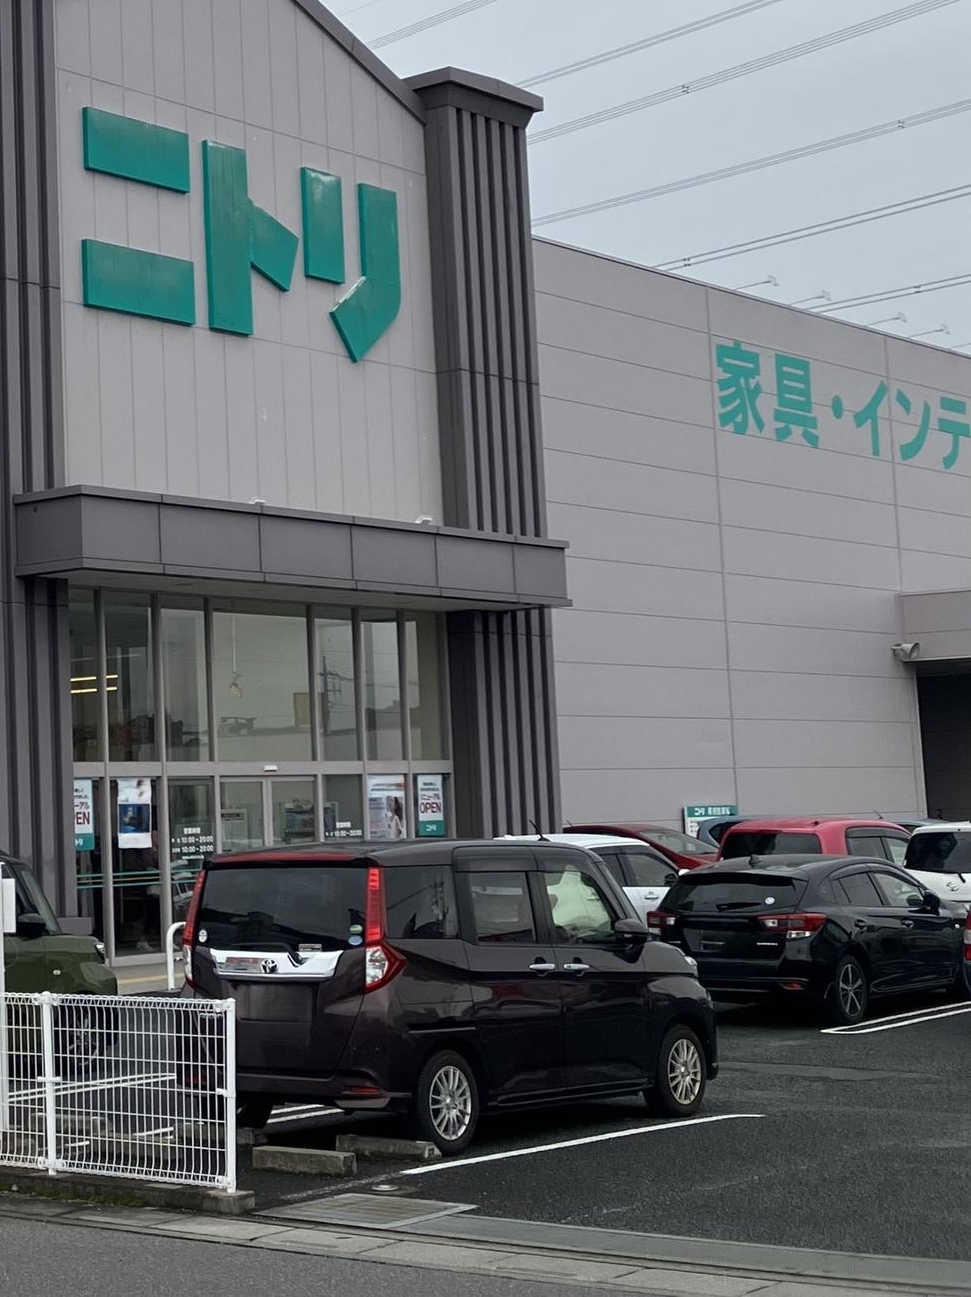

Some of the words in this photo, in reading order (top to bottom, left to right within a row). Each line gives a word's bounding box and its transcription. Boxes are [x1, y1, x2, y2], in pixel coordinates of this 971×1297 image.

[82, 106, 401, 363] ニトリ
[715, 338, 971, 470] 家具・インテ
[419, 801, 442, 814] OPEN
